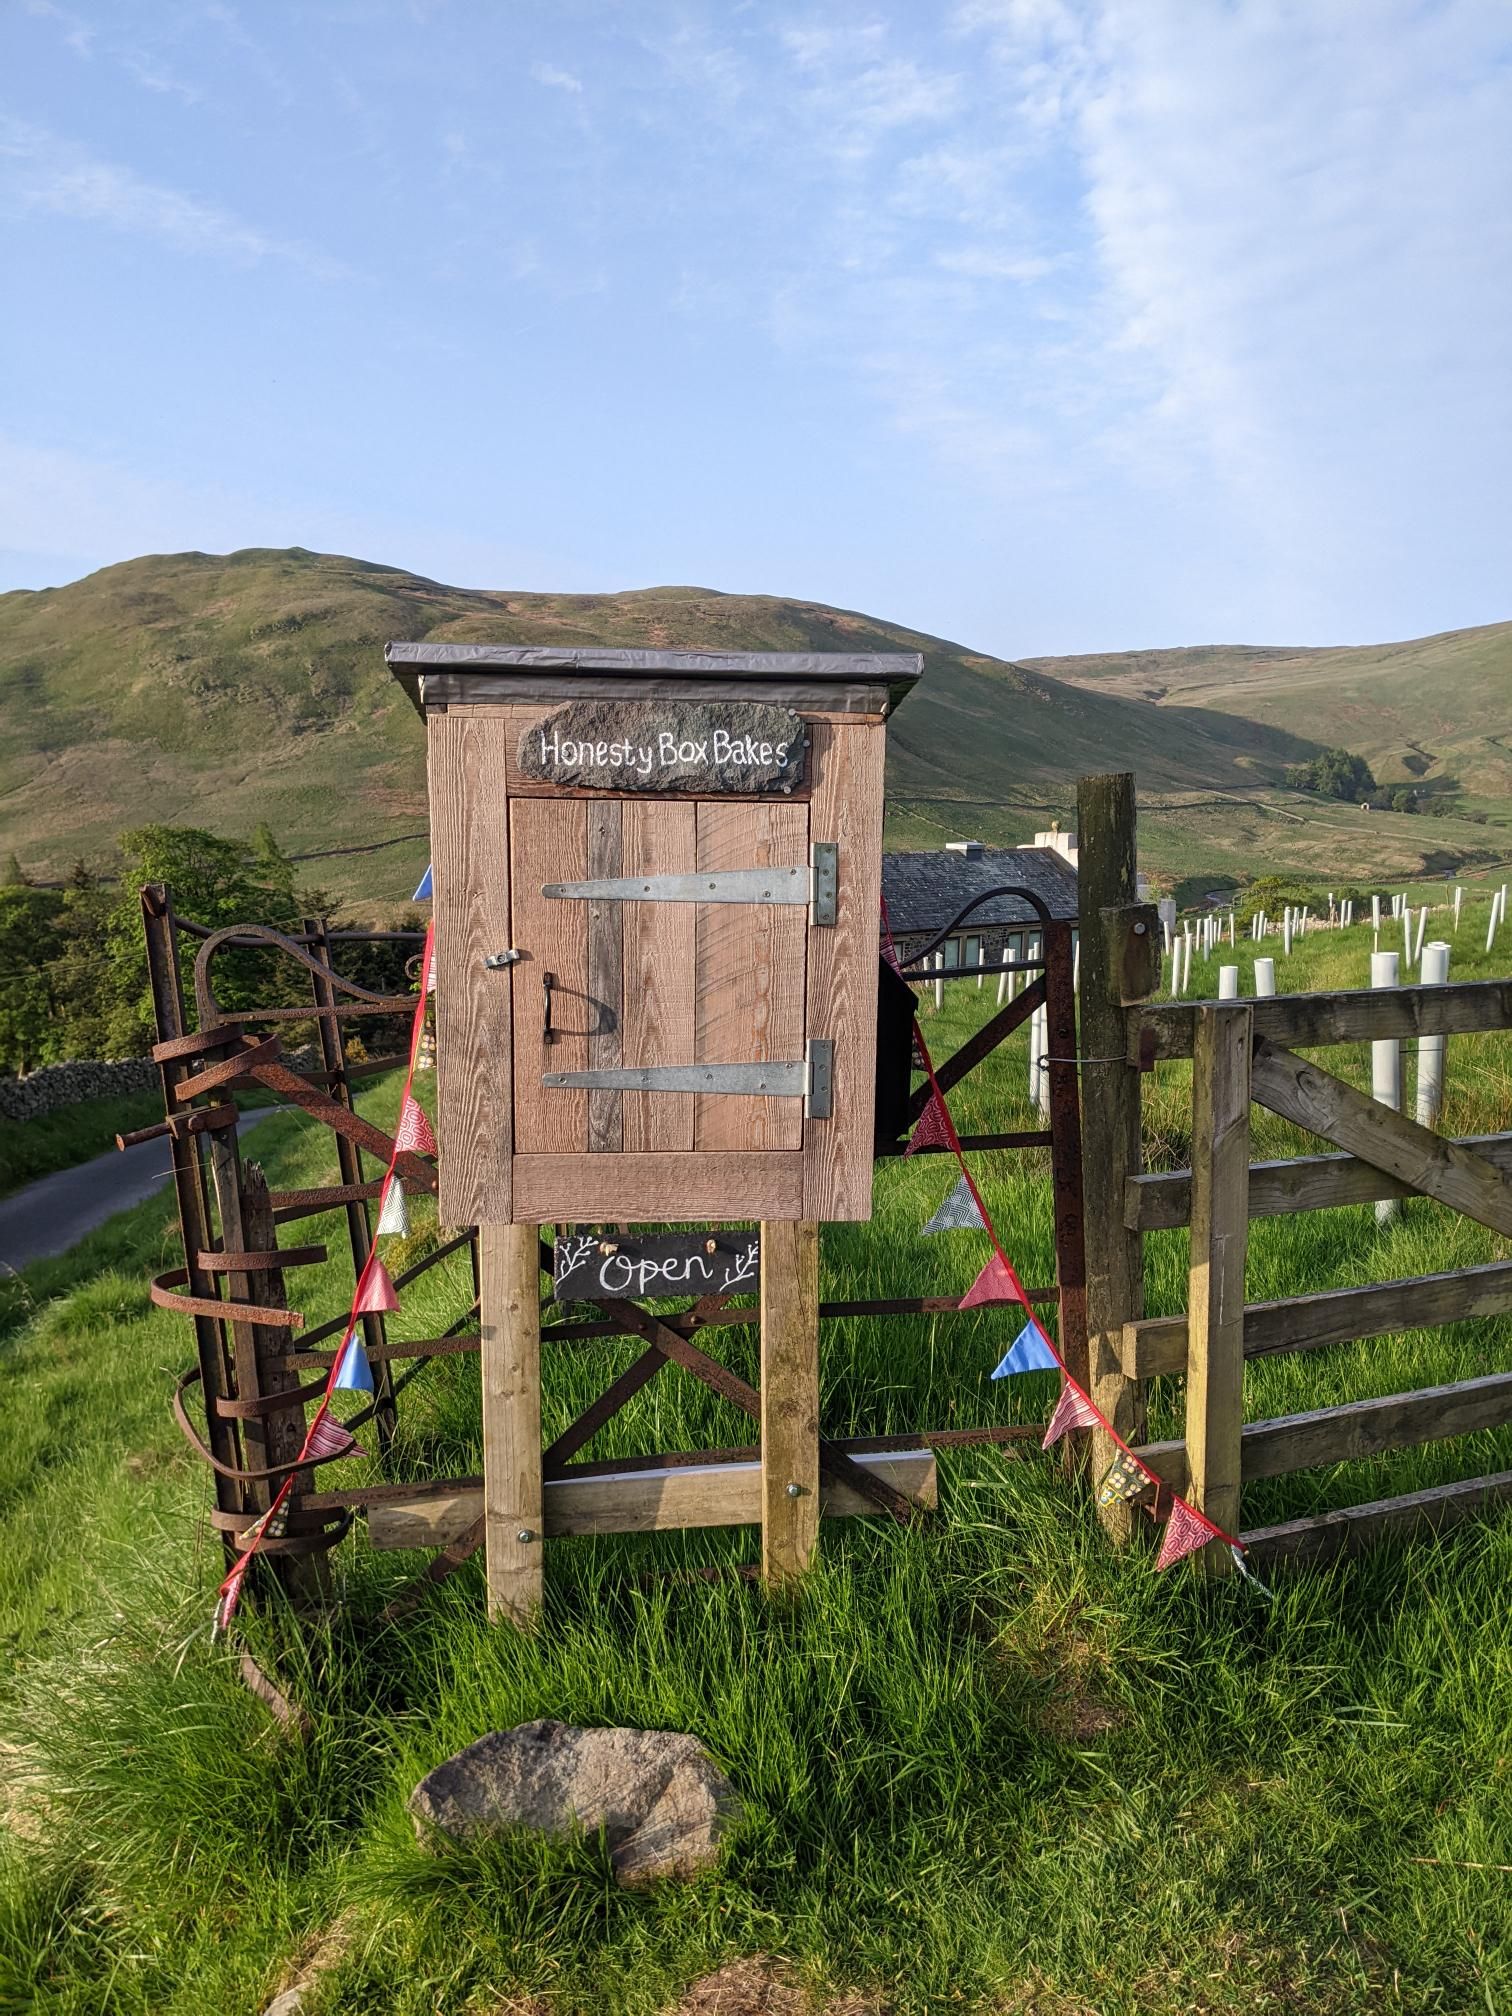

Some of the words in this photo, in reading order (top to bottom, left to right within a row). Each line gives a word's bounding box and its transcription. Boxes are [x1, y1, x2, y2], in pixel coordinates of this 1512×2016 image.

[540, 730, 652, 773] Honesty
[658, 732, 709, 766] Box
[713, 729, 788, 768] Bakes
[599, 1255, 714, 1295] Open
